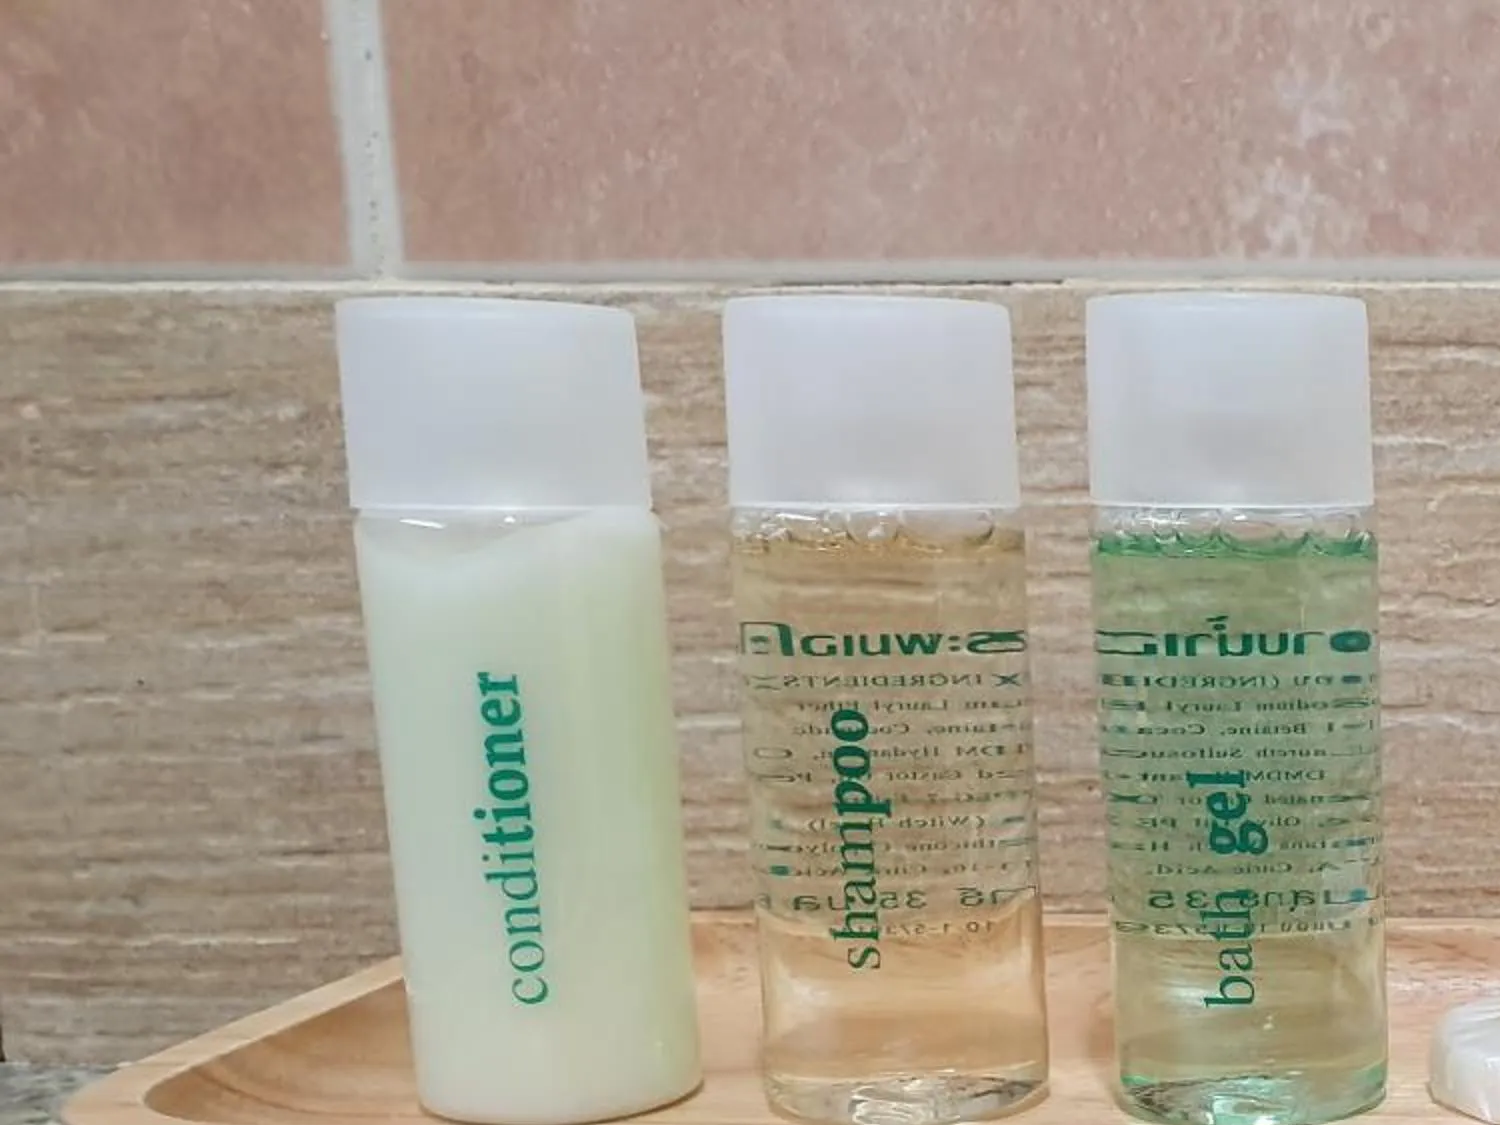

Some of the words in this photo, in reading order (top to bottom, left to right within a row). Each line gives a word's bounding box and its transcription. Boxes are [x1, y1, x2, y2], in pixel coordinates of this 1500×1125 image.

[473, 671, 549, 1005] conditioner
[829, 708, 894, 970] shampoo
[1184, 769, 1269, 856] gel
[1200, 888, 1256, 1008] bath
